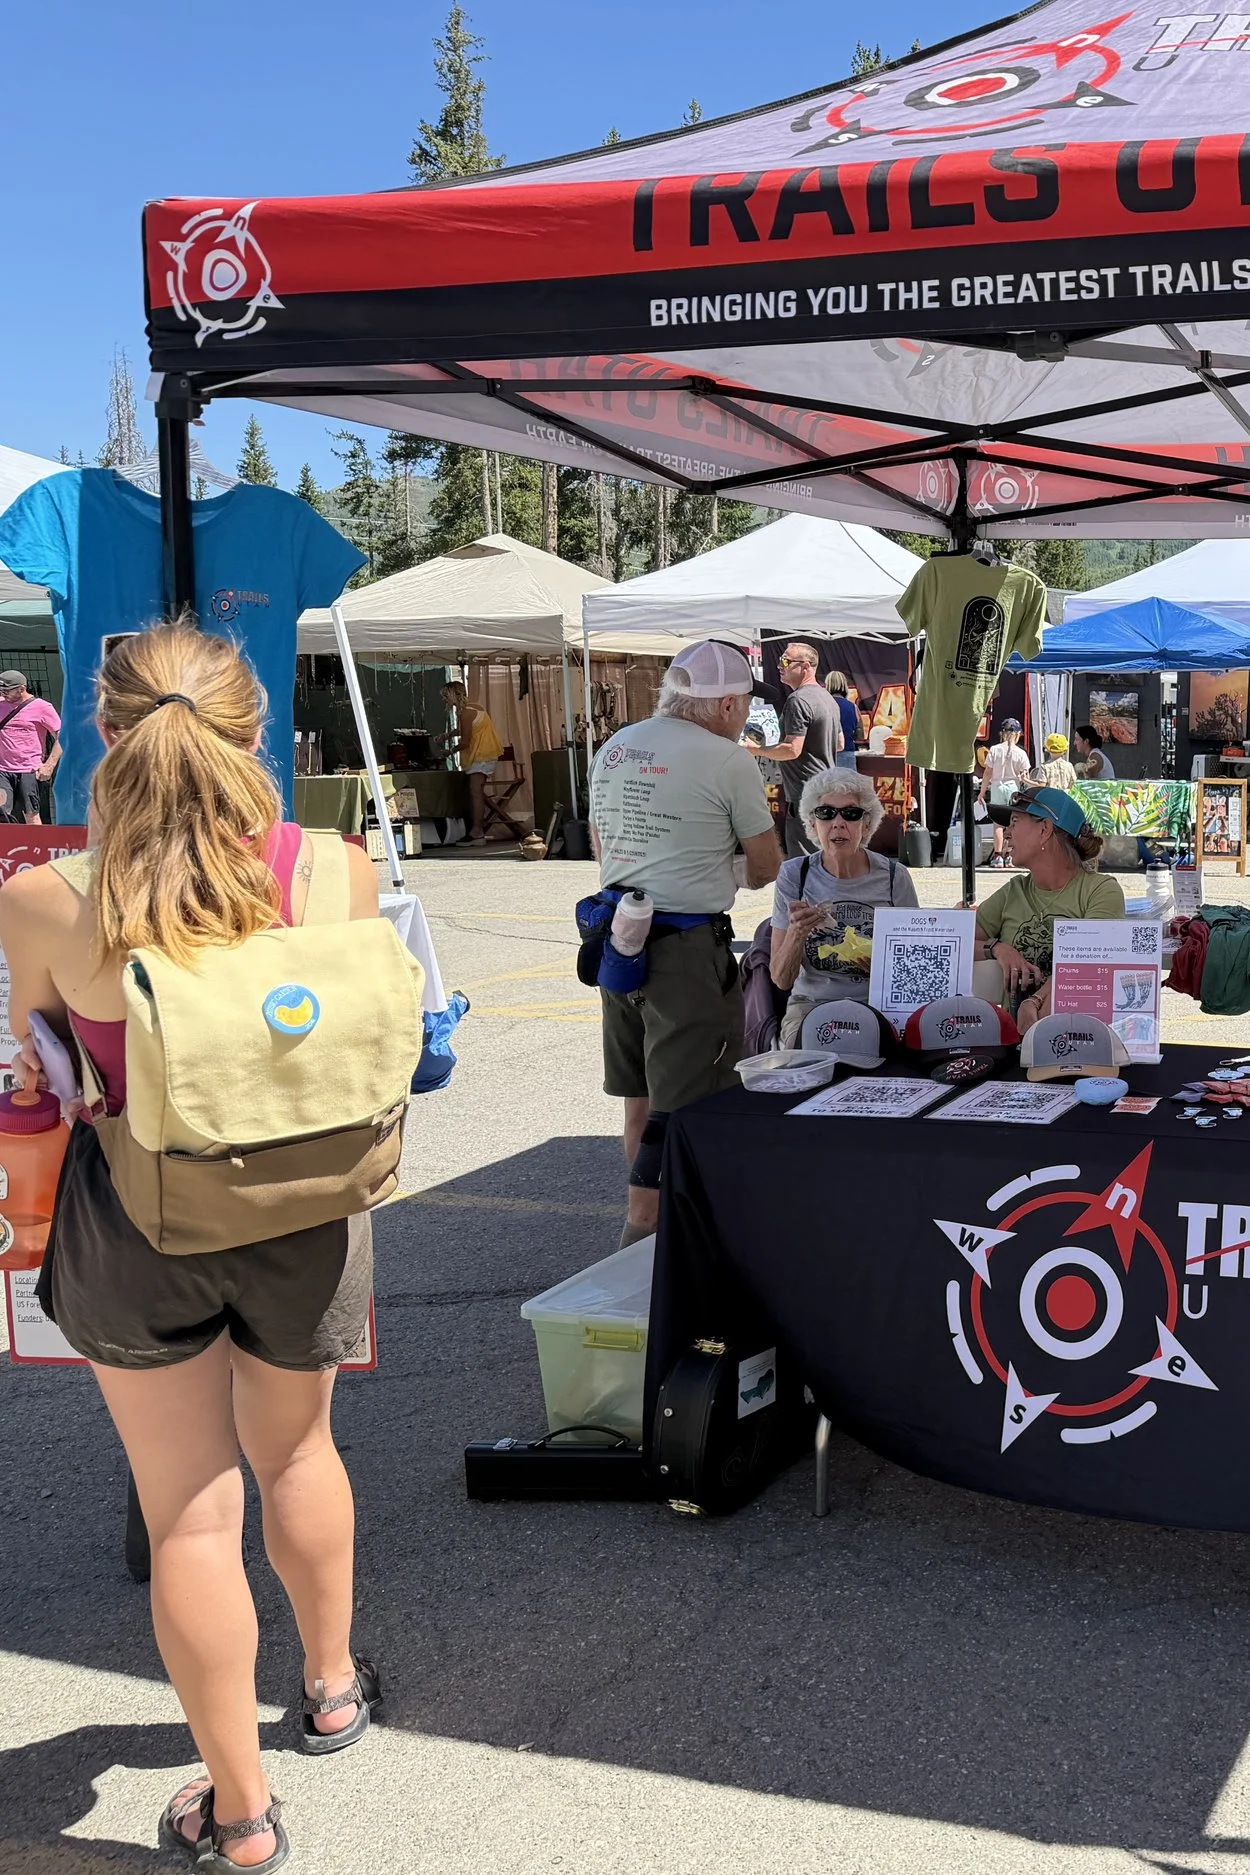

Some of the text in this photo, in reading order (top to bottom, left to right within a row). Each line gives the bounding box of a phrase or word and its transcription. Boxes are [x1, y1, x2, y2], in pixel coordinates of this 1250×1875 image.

[633, 142, 1063, 252] TRAILS
[650, 290, 797, 326] BRINGING
[806, 284, 870, 317] YOU
[877, 280, 940, 311] THE
[950, 267, 1119, 307] GREATEST
[833, 1020, 860, 1031] TRAILS
[955, 1015, 982, 1025] TRAILS
[1068, 1032, 1094, 1040] TRAILS
